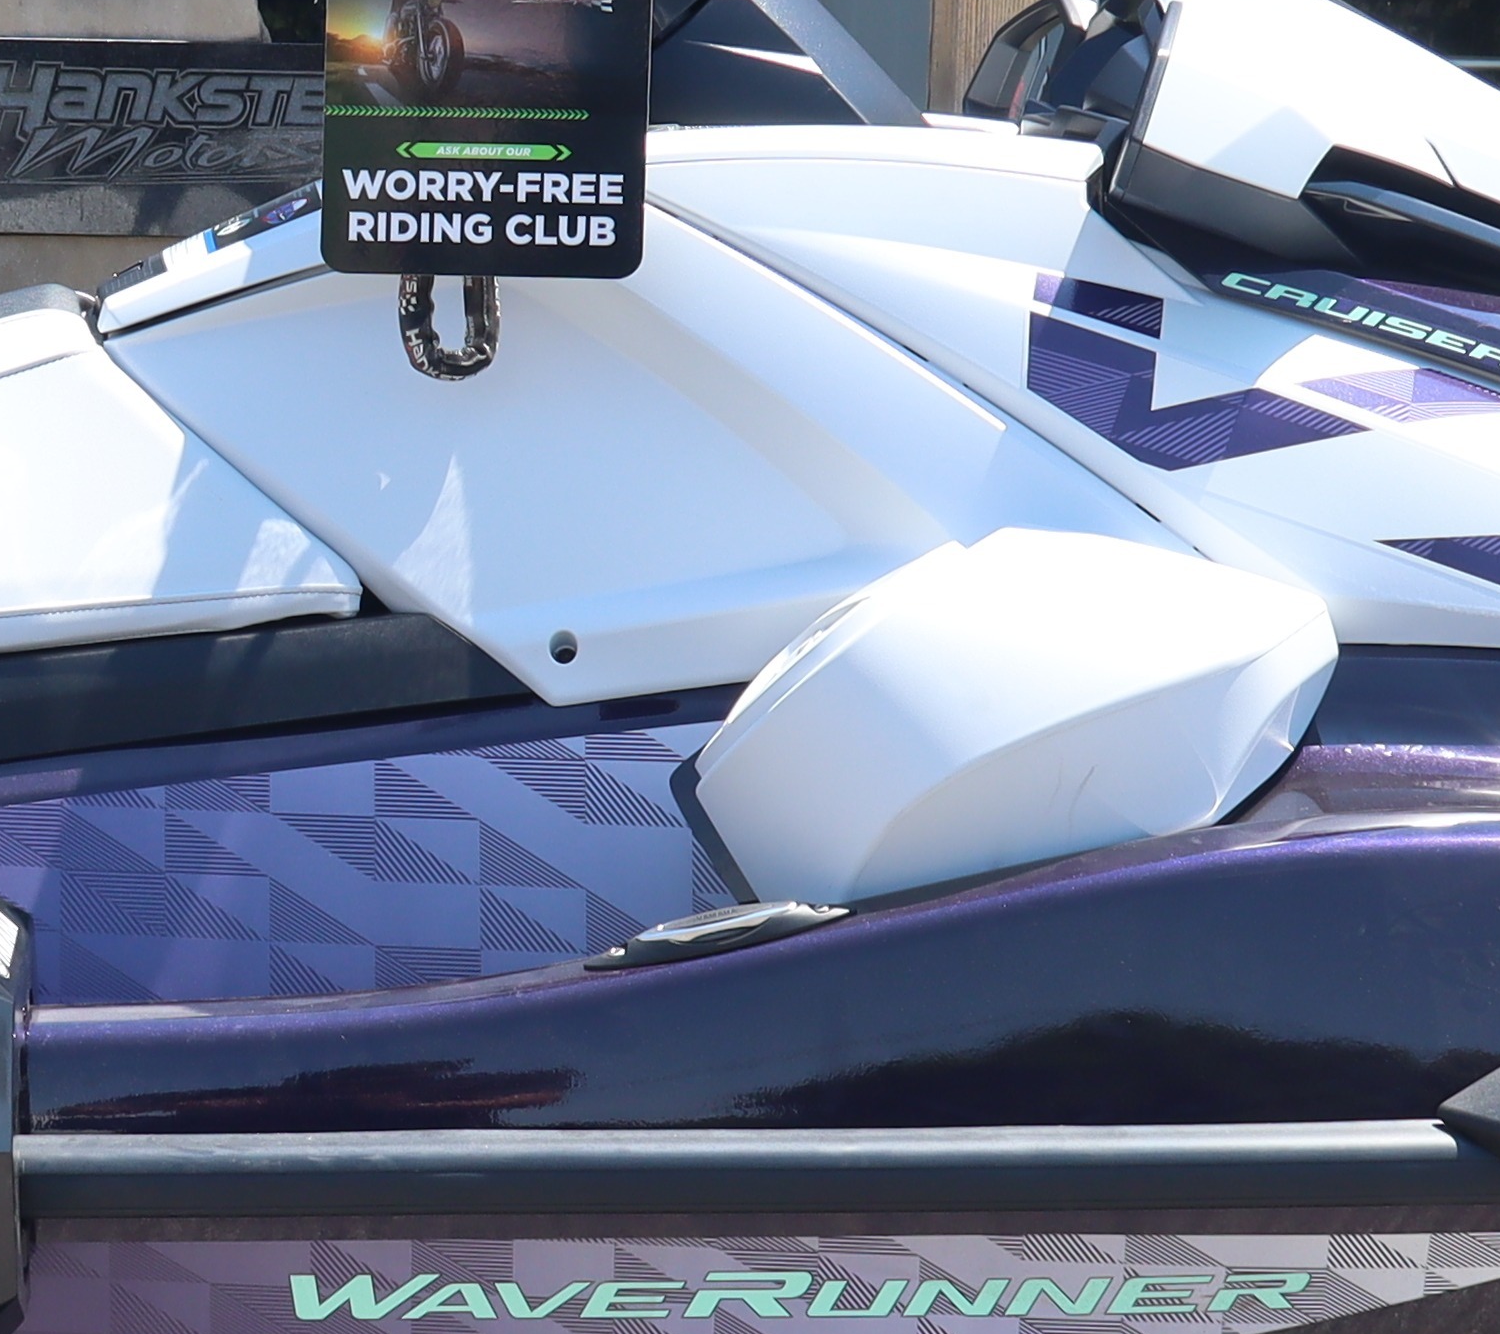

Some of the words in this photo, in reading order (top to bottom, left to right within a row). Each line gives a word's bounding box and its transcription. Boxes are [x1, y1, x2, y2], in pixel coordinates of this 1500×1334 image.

[436, 146, 460, 156] ASK
[462, 146, 505, 156] ABOUT
[506, 147, 532, 157] OUR
[342, 169, 624, 205] WORRY-FREE
[348, 211, 493, 244] RIDING
[505, 214, 616, 246] CLUB
[289, 1271, 1312, 1319] WAVERUNNER
